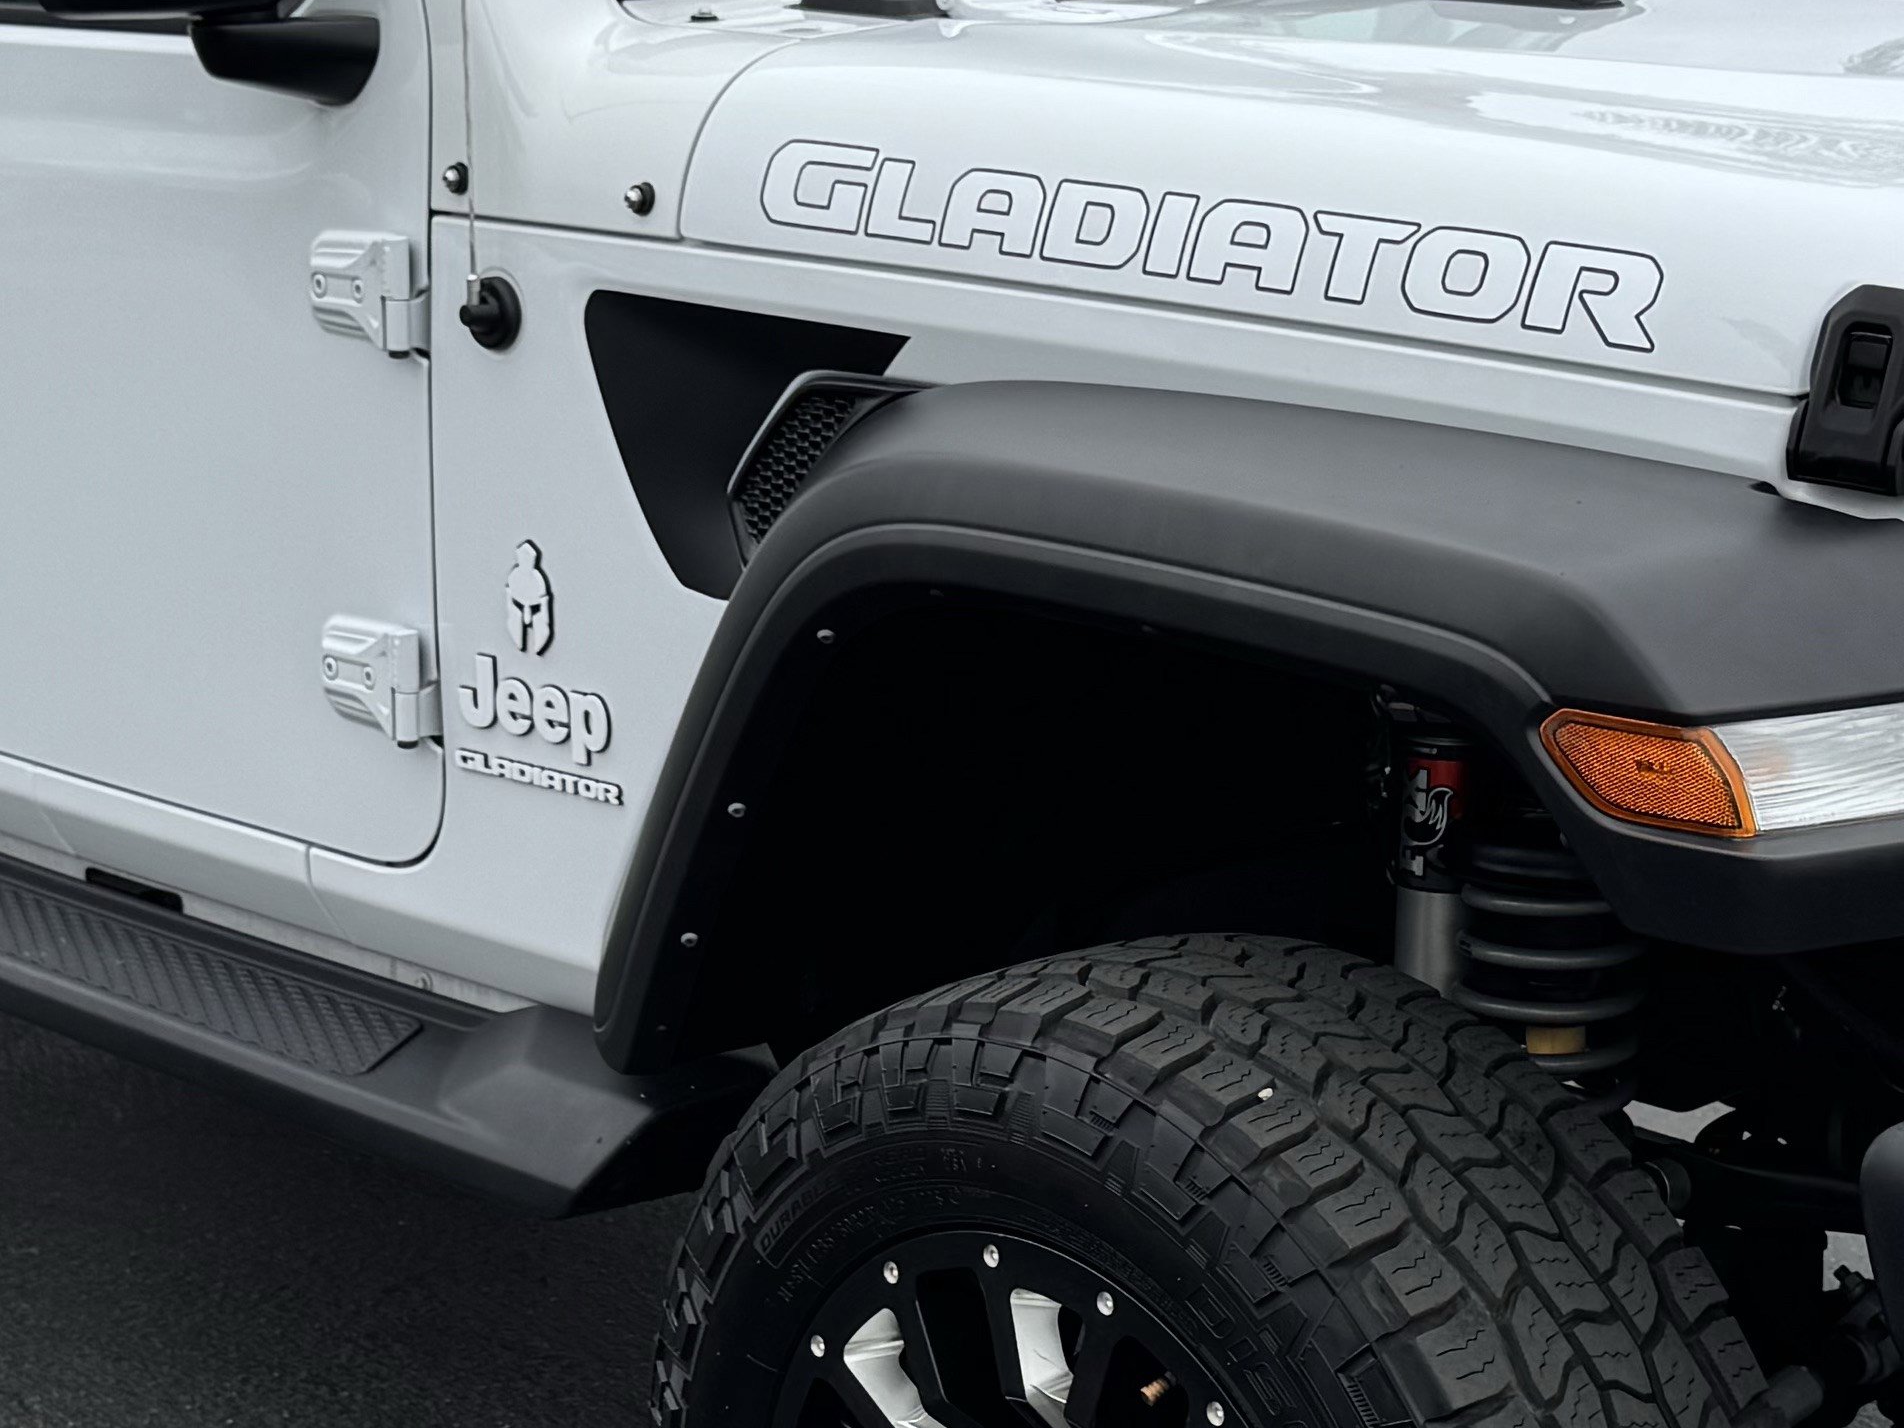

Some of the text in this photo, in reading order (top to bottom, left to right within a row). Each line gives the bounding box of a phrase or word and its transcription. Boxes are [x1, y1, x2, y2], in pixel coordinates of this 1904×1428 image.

[760, 138, 1664, 353] GLADIATOR
[459, 653, 612, 766] Jeep
[454, 748, 624, 805] GLADIATOR
